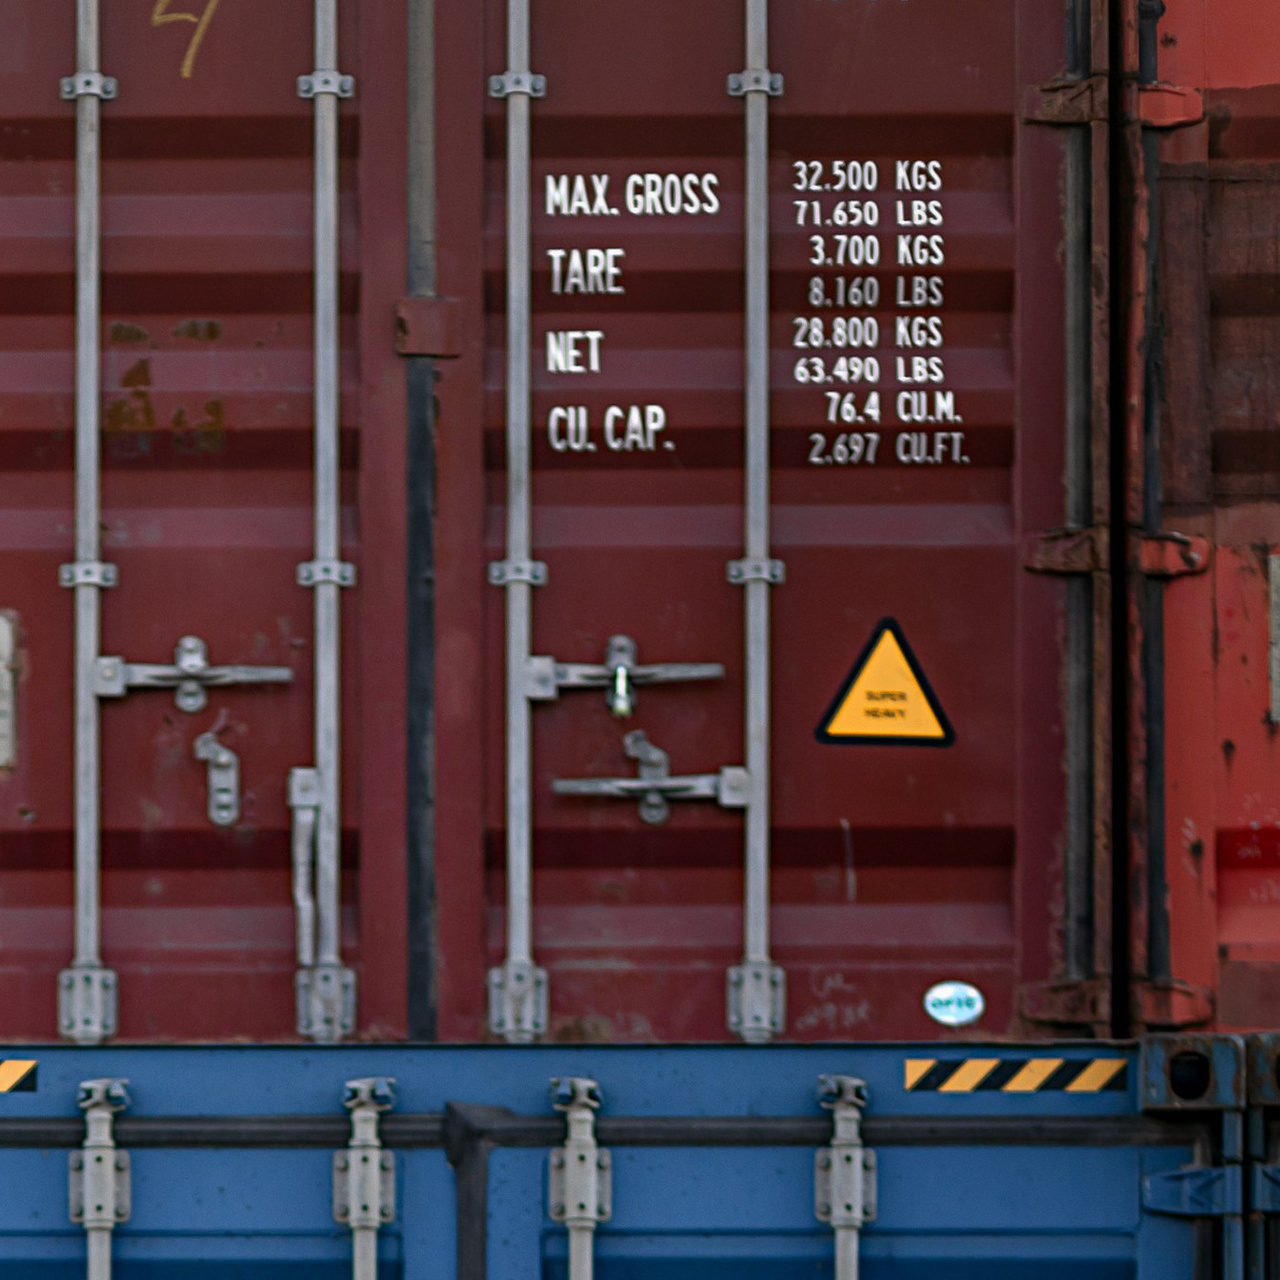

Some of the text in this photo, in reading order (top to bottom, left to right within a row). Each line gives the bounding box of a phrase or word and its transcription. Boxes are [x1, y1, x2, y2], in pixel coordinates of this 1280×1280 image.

[793, 160, 942, 191] 32.500 KGS
[545, 173, 720, 215] MAX. GROSS
[793, 200, 943, 227] 71.650 LBS
[809, 235, 944, 267] 3.700 KGS
[547, 248, 625, 294] TARE
[808, 276, 944, 306] 8.160 LBS
[793, 316, 943, 348] 28.800 KGS
[545, 331, 604, 373] NET
[793, 356, 944, 384] 63.490 LBS
[825, 391, 963, 423] 76.4 CU.M.
[547, 404, 675, 451] CU. CAP.
[808, 432, 970, 464] 2.697 CU.FT.
